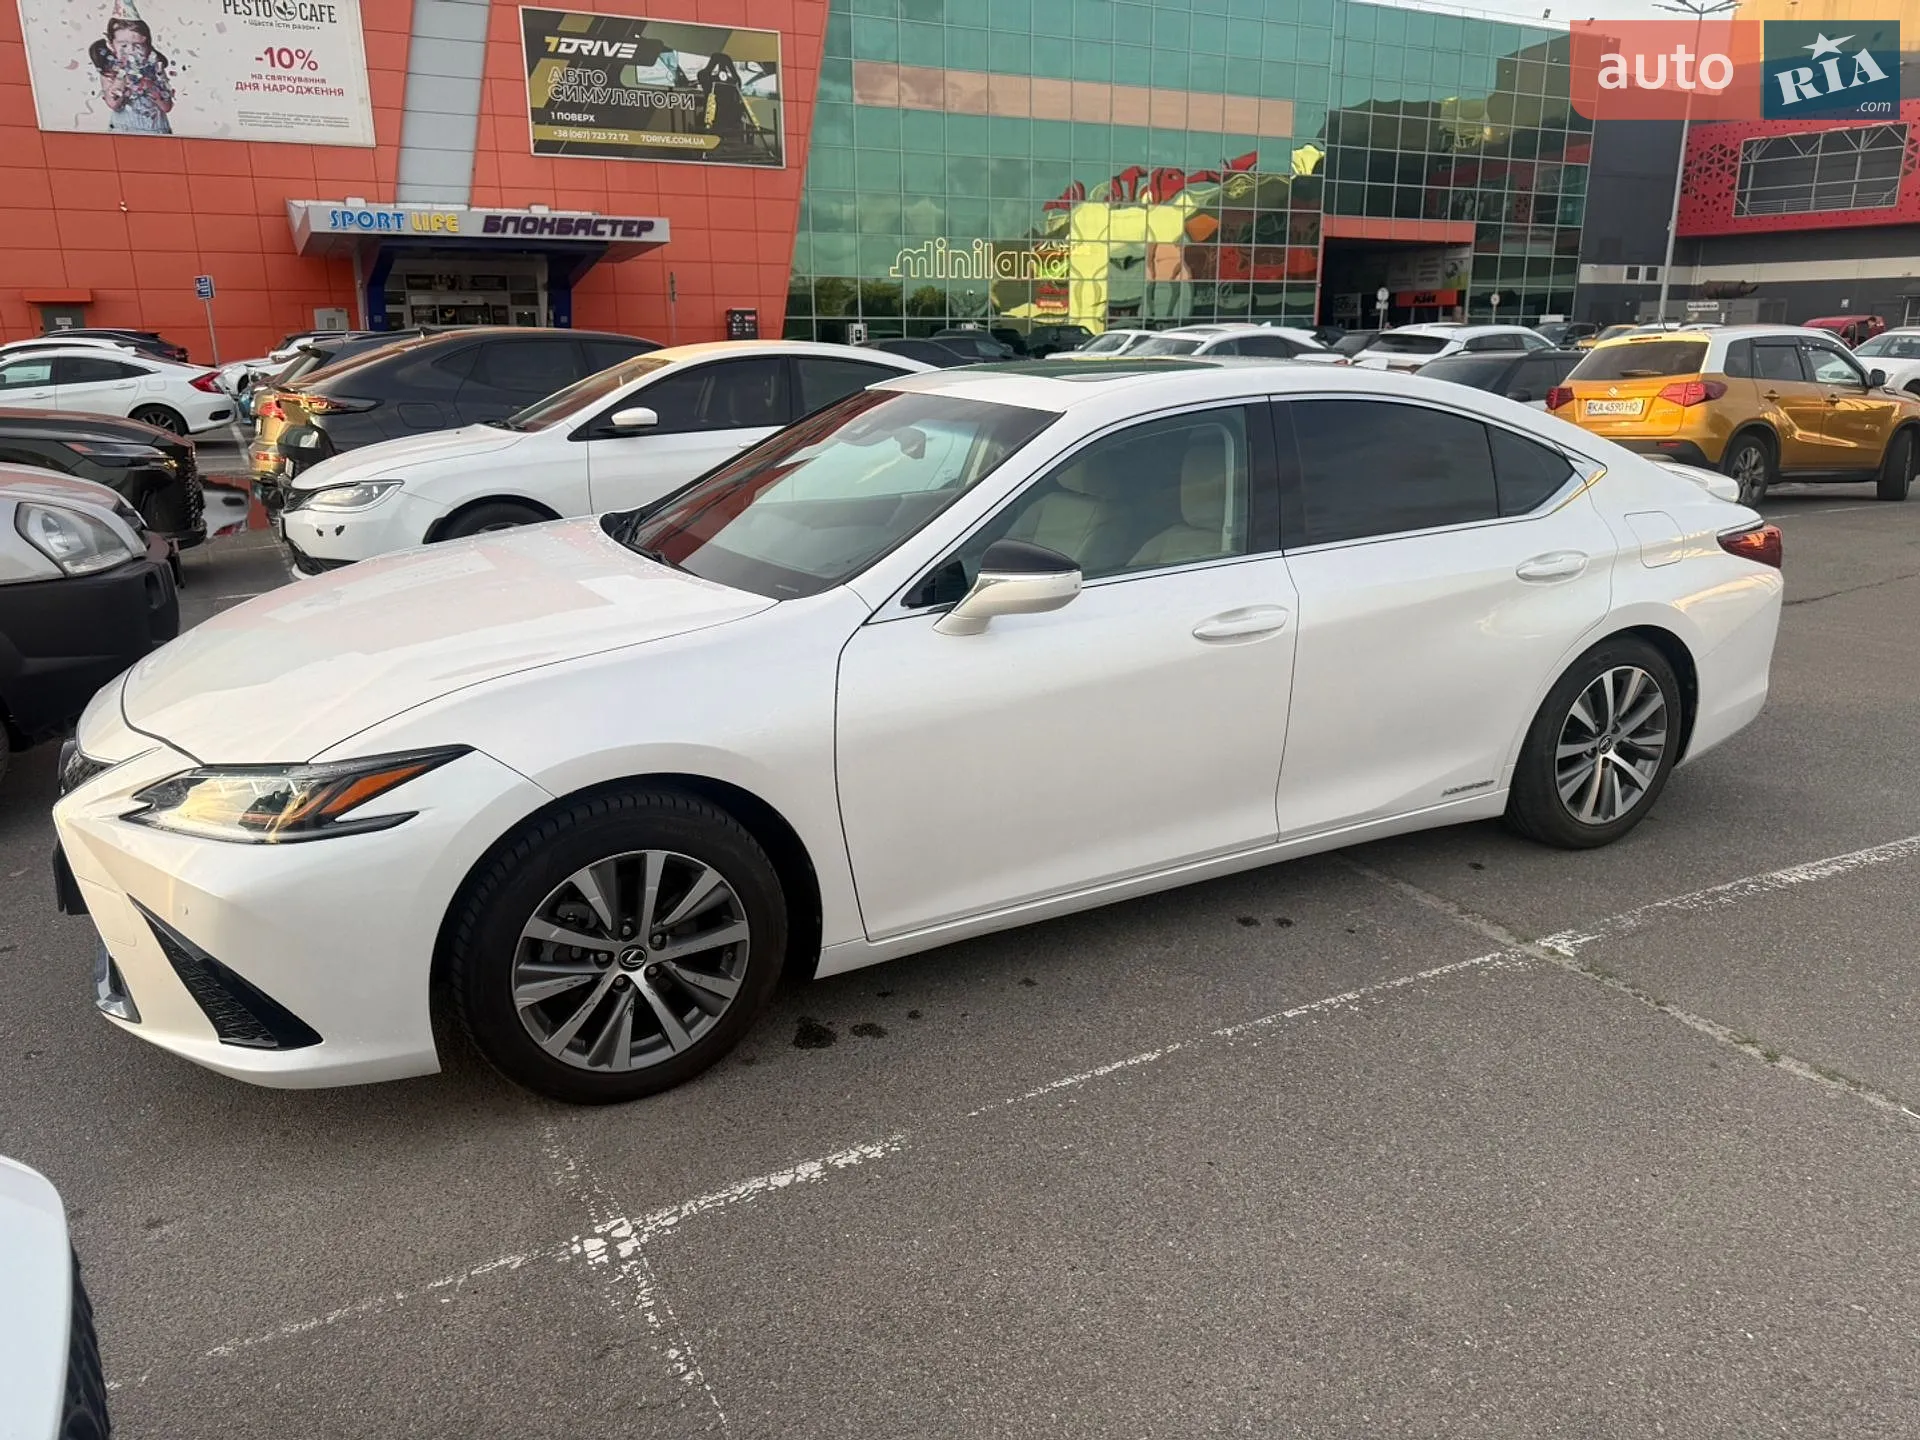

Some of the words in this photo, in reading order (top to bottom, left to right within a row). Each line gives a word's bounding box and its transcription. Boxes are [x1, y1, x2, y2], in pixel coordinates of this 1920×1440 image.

[223, 0, 272, 18] PESTO
[299, 2, 337, 23] CAFE
[255, 46, 319, 71] -10%
[544, 36, 638, 59] 7DRIVE
[265, 74, 327, 84] святкування
[548, 66, 608, 87] АВТО
[235, 81, 260, 91] ДНЯ
[263, 83, 344, 97] НАРОДЖЕННЯ
[549, 84, 695, 111] СИМУЛЯТОРИ
[550, 111, 555, 120] 1
[557, 112, 595, 122] ПОВЕРХ
[553, 129, 568, 138] +38
[641, 134, 705, 145] 7DRIVE.COM.UA
[329, 209, 405, 231] SPORT
[411, 212, 459, 233] LIFE
[482, 214, 655, 238] БЛОКБАСТЕР
